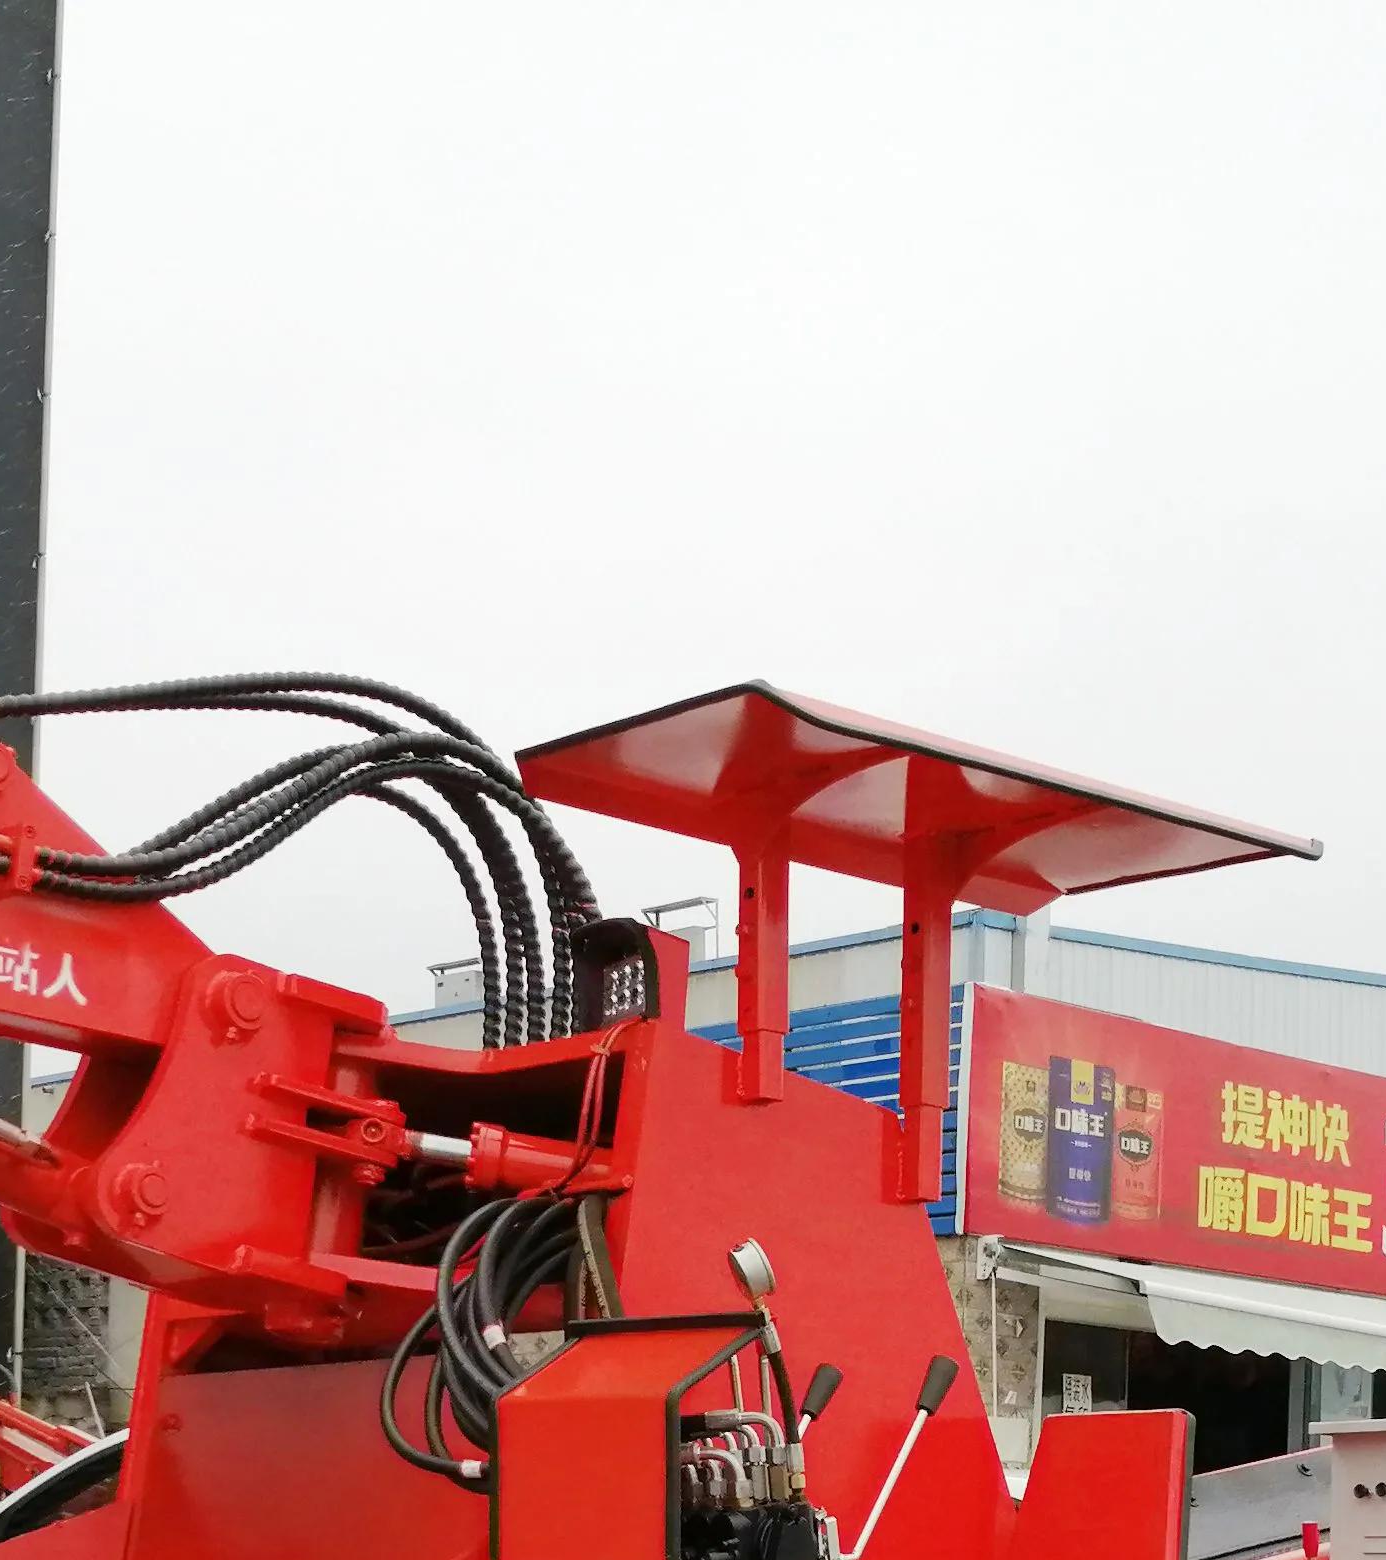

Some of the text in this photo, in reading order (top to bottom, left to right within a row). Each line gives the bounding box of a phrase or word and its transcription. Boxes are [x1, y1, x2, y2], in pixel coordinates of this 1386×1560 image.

[1054, 1107, 1105, 1138] 口味王
[1221, 1080, 1351, 1167] 提神快
[1197, 1165, 1373, 1254] 嚼口味王
